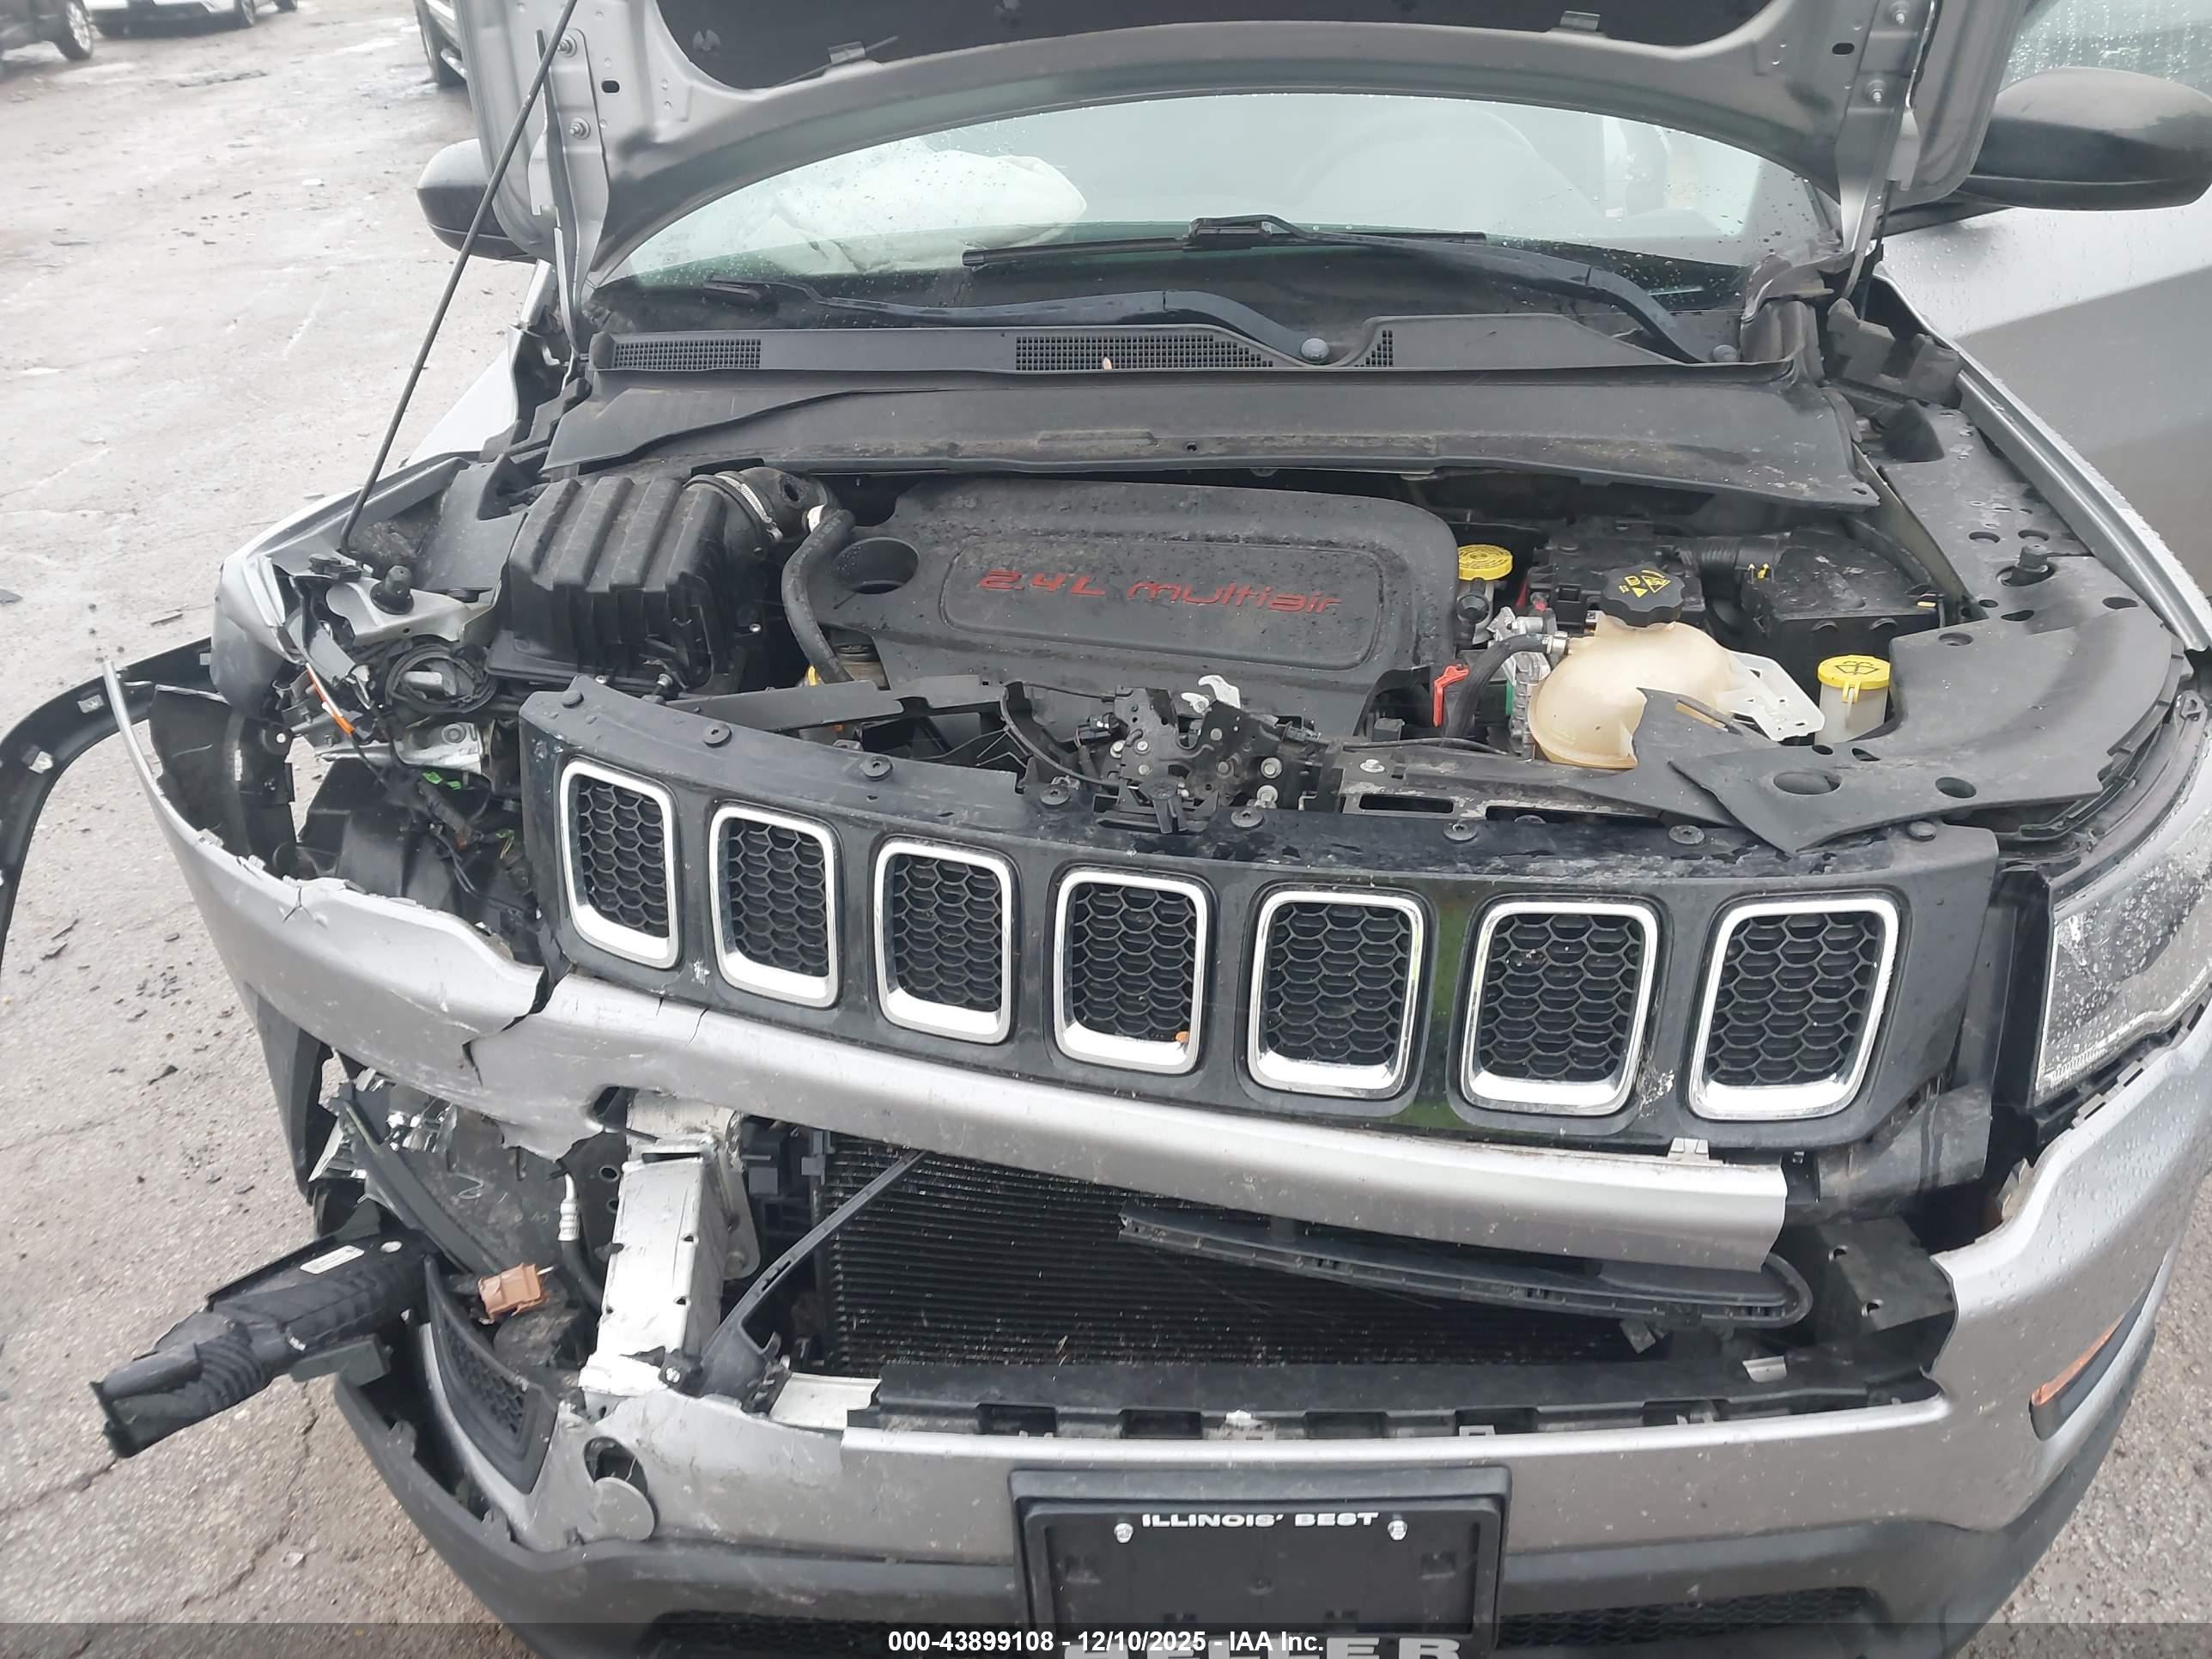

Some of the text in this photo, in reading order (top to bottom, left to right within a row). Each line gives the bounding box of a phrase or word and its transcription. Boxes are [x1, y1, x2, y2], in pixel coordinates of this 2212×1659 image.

[977, 568, 1342, 614] 2.4L multiair
[1142, 1512, 1379, 1528] ILLINOIS' BEST
